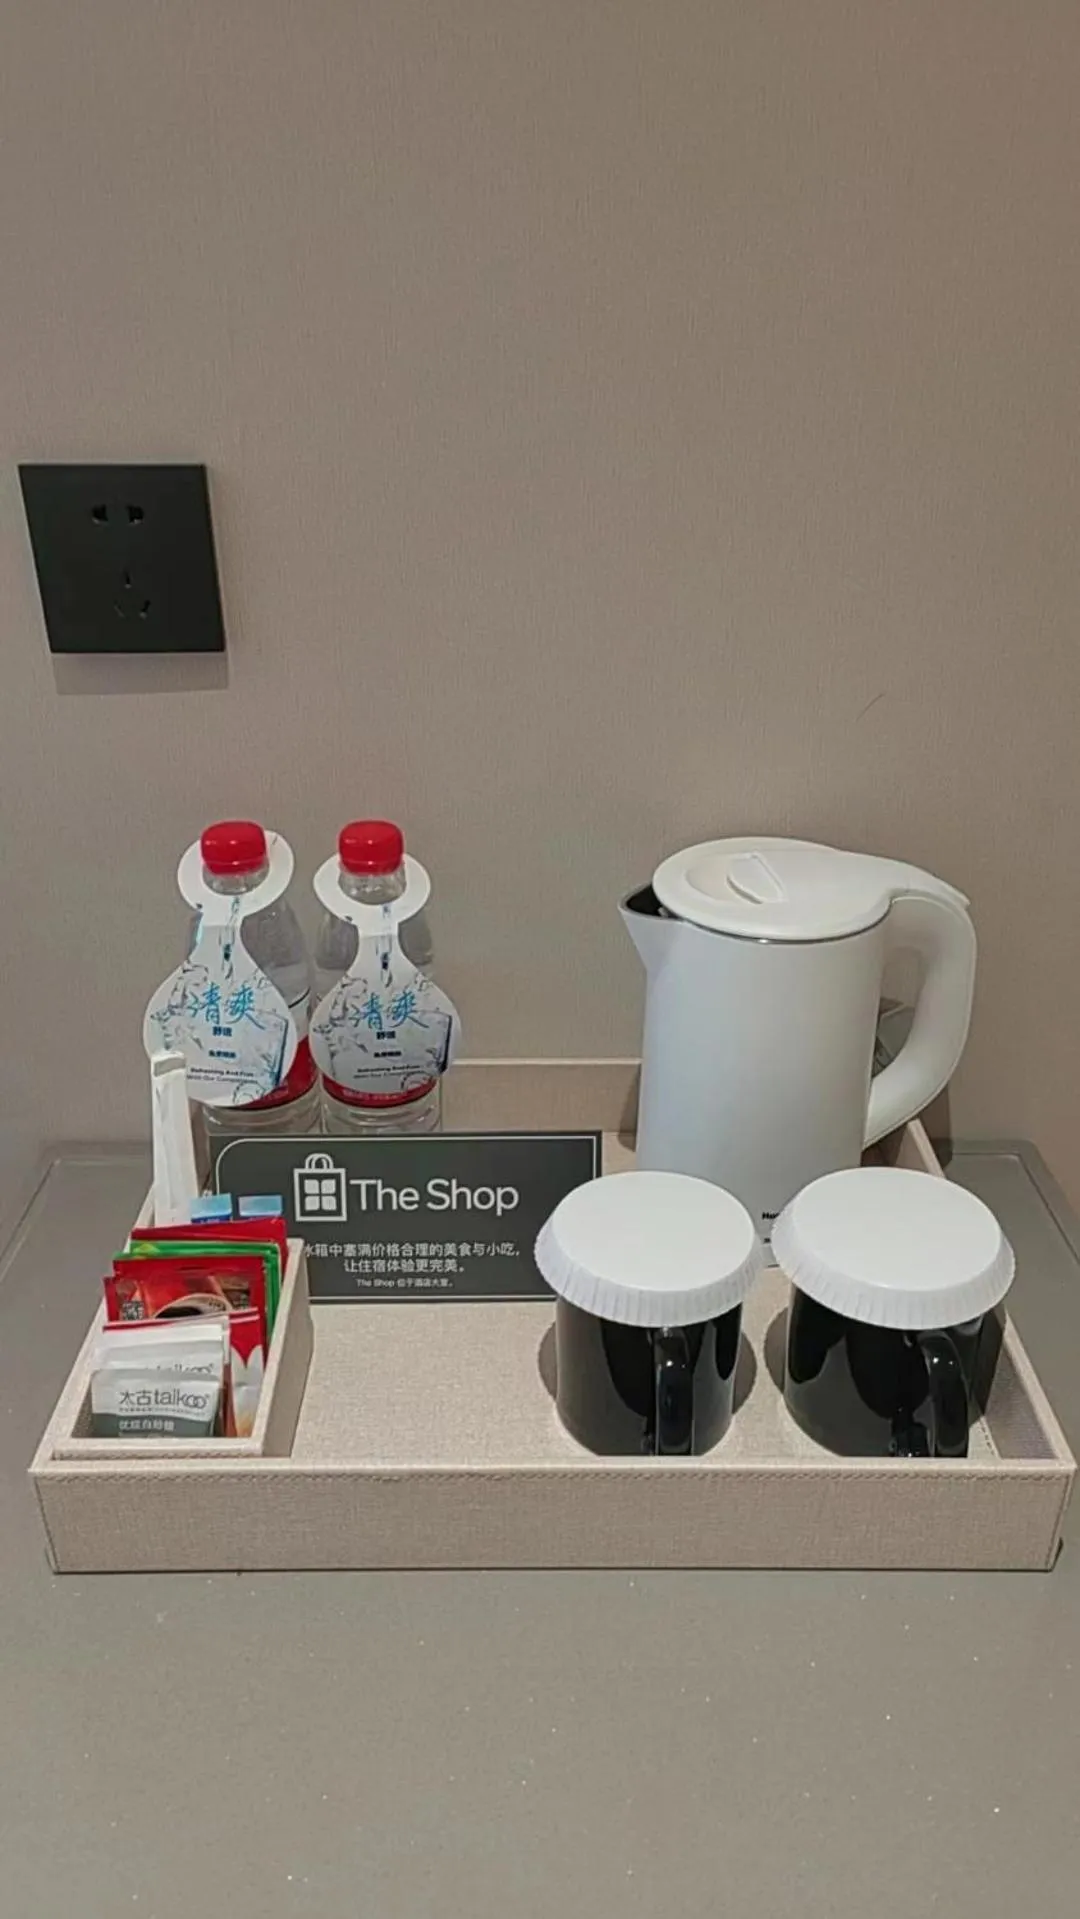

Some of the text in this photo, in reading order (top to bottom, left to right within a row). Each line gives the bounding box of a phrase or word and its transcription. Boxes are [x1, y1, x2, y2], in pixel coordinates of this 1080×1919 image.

[187, 981, 266, 1030] 清爽
[348, 988, 430, 1030] 清爽
[349, 1178, 519, 1216] The Shop
